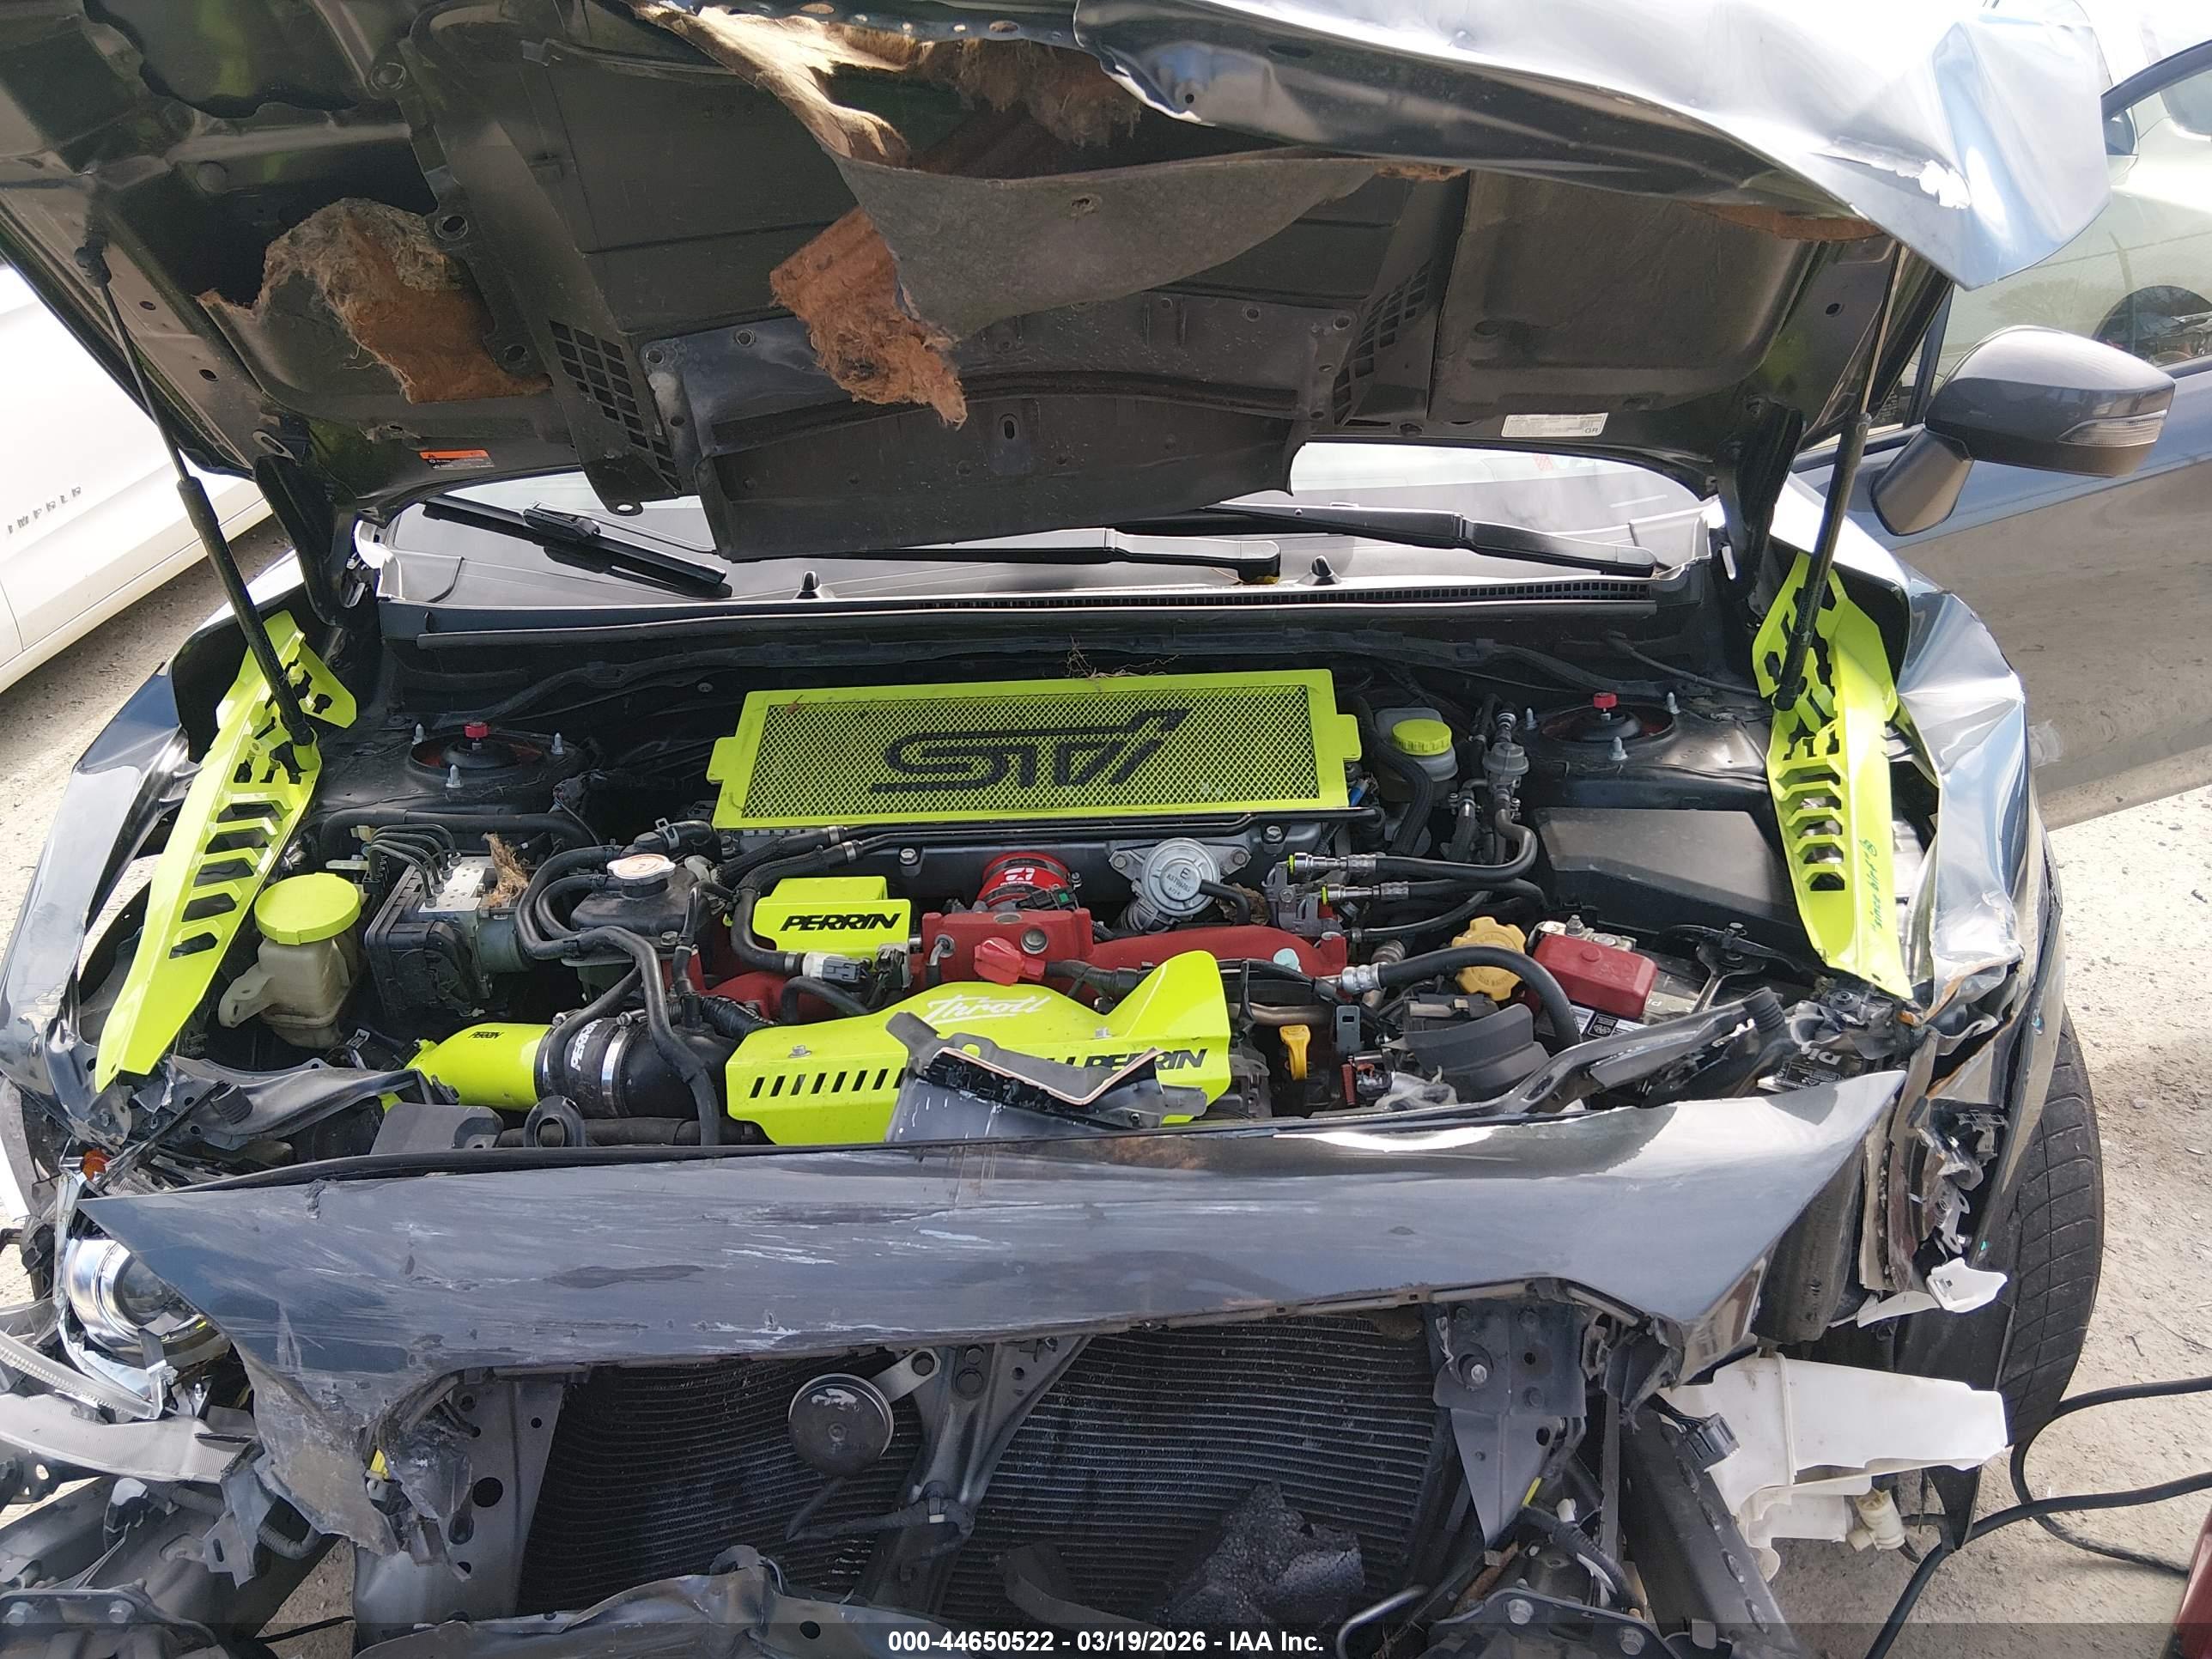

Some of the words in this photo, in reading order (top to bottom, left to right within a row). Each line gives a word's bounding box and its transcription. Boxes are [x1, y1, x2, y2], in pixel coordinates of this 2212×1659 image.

[780, 912, 902, 932] PERRIN
[569, 1018, 604, 1072] PERRIN
[1084, 1048, 1209, 1071] PERIN
